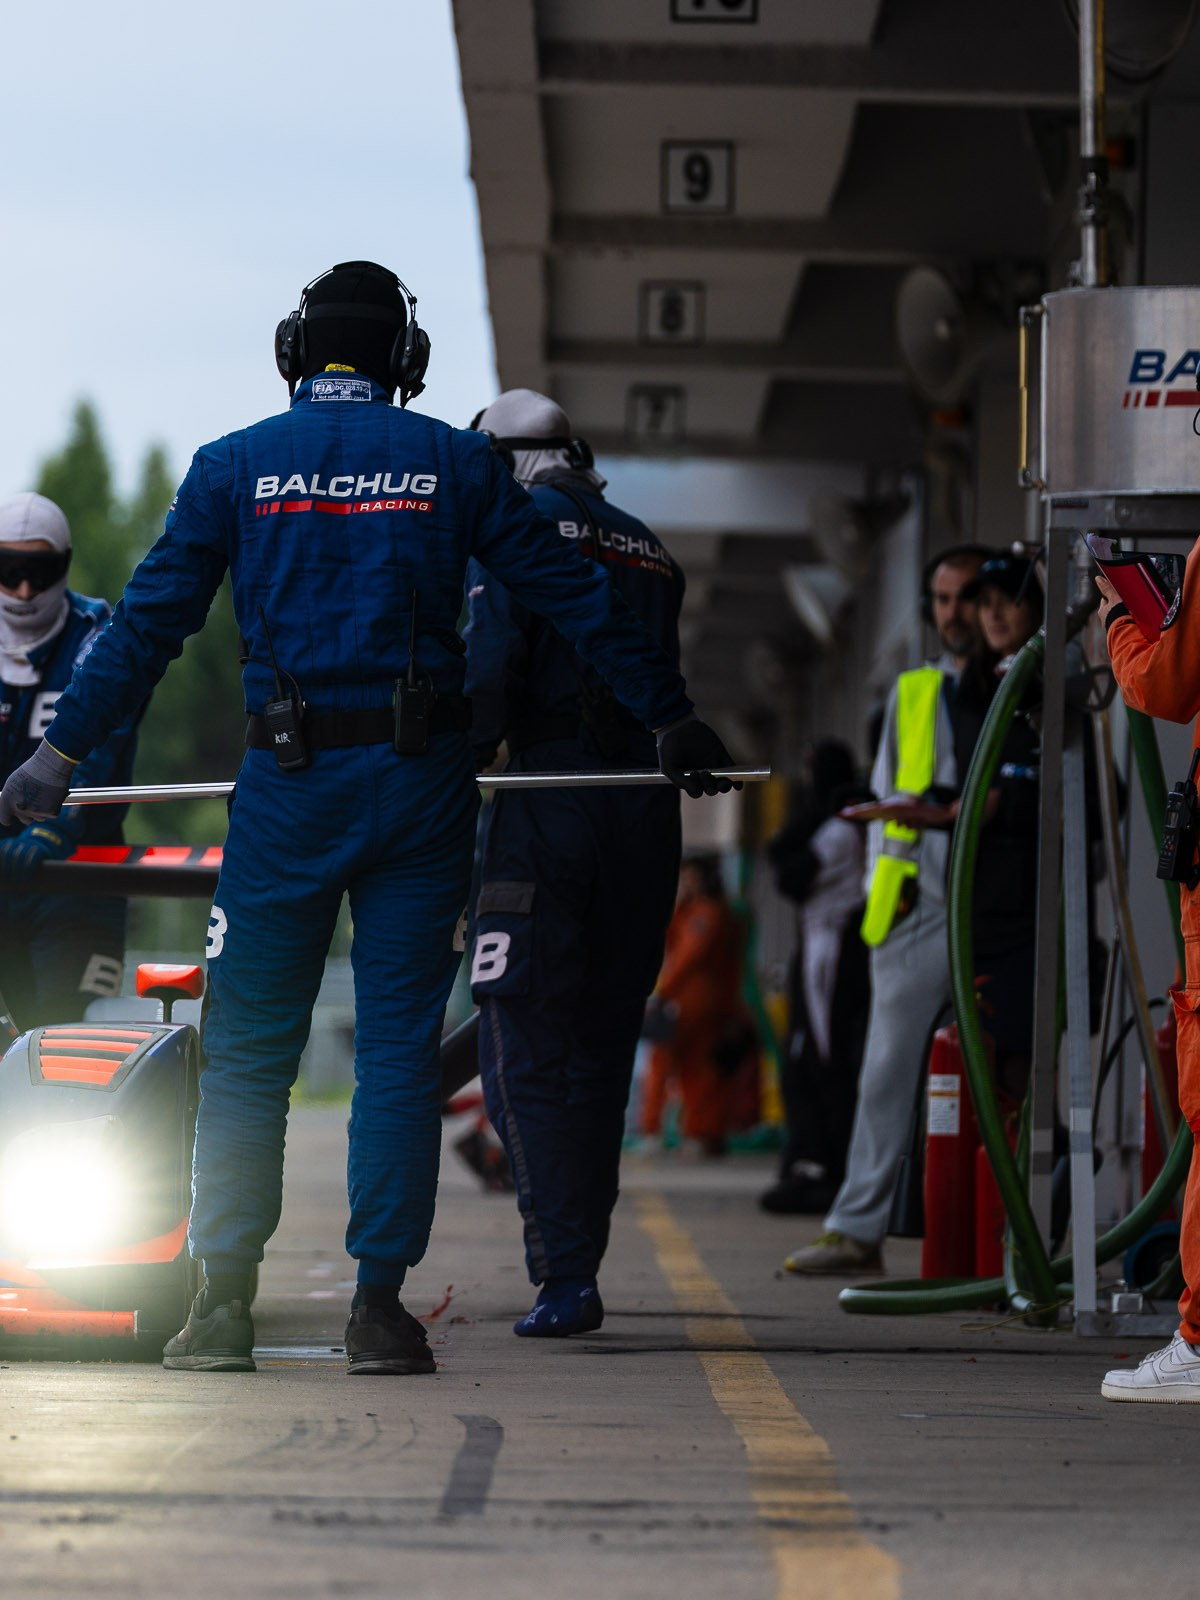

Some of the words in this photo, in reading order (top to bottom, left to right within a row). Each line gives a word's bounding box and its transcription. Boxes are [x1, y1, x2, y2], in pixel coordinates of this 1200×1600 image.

[683, 152, 714, 203] 9
[314, 383, 334, 393] FIA
[255, 473, 438, 499] BALCHUG
[360, 500, 429, 512] RACING
[470, 931, 511, 985] B
